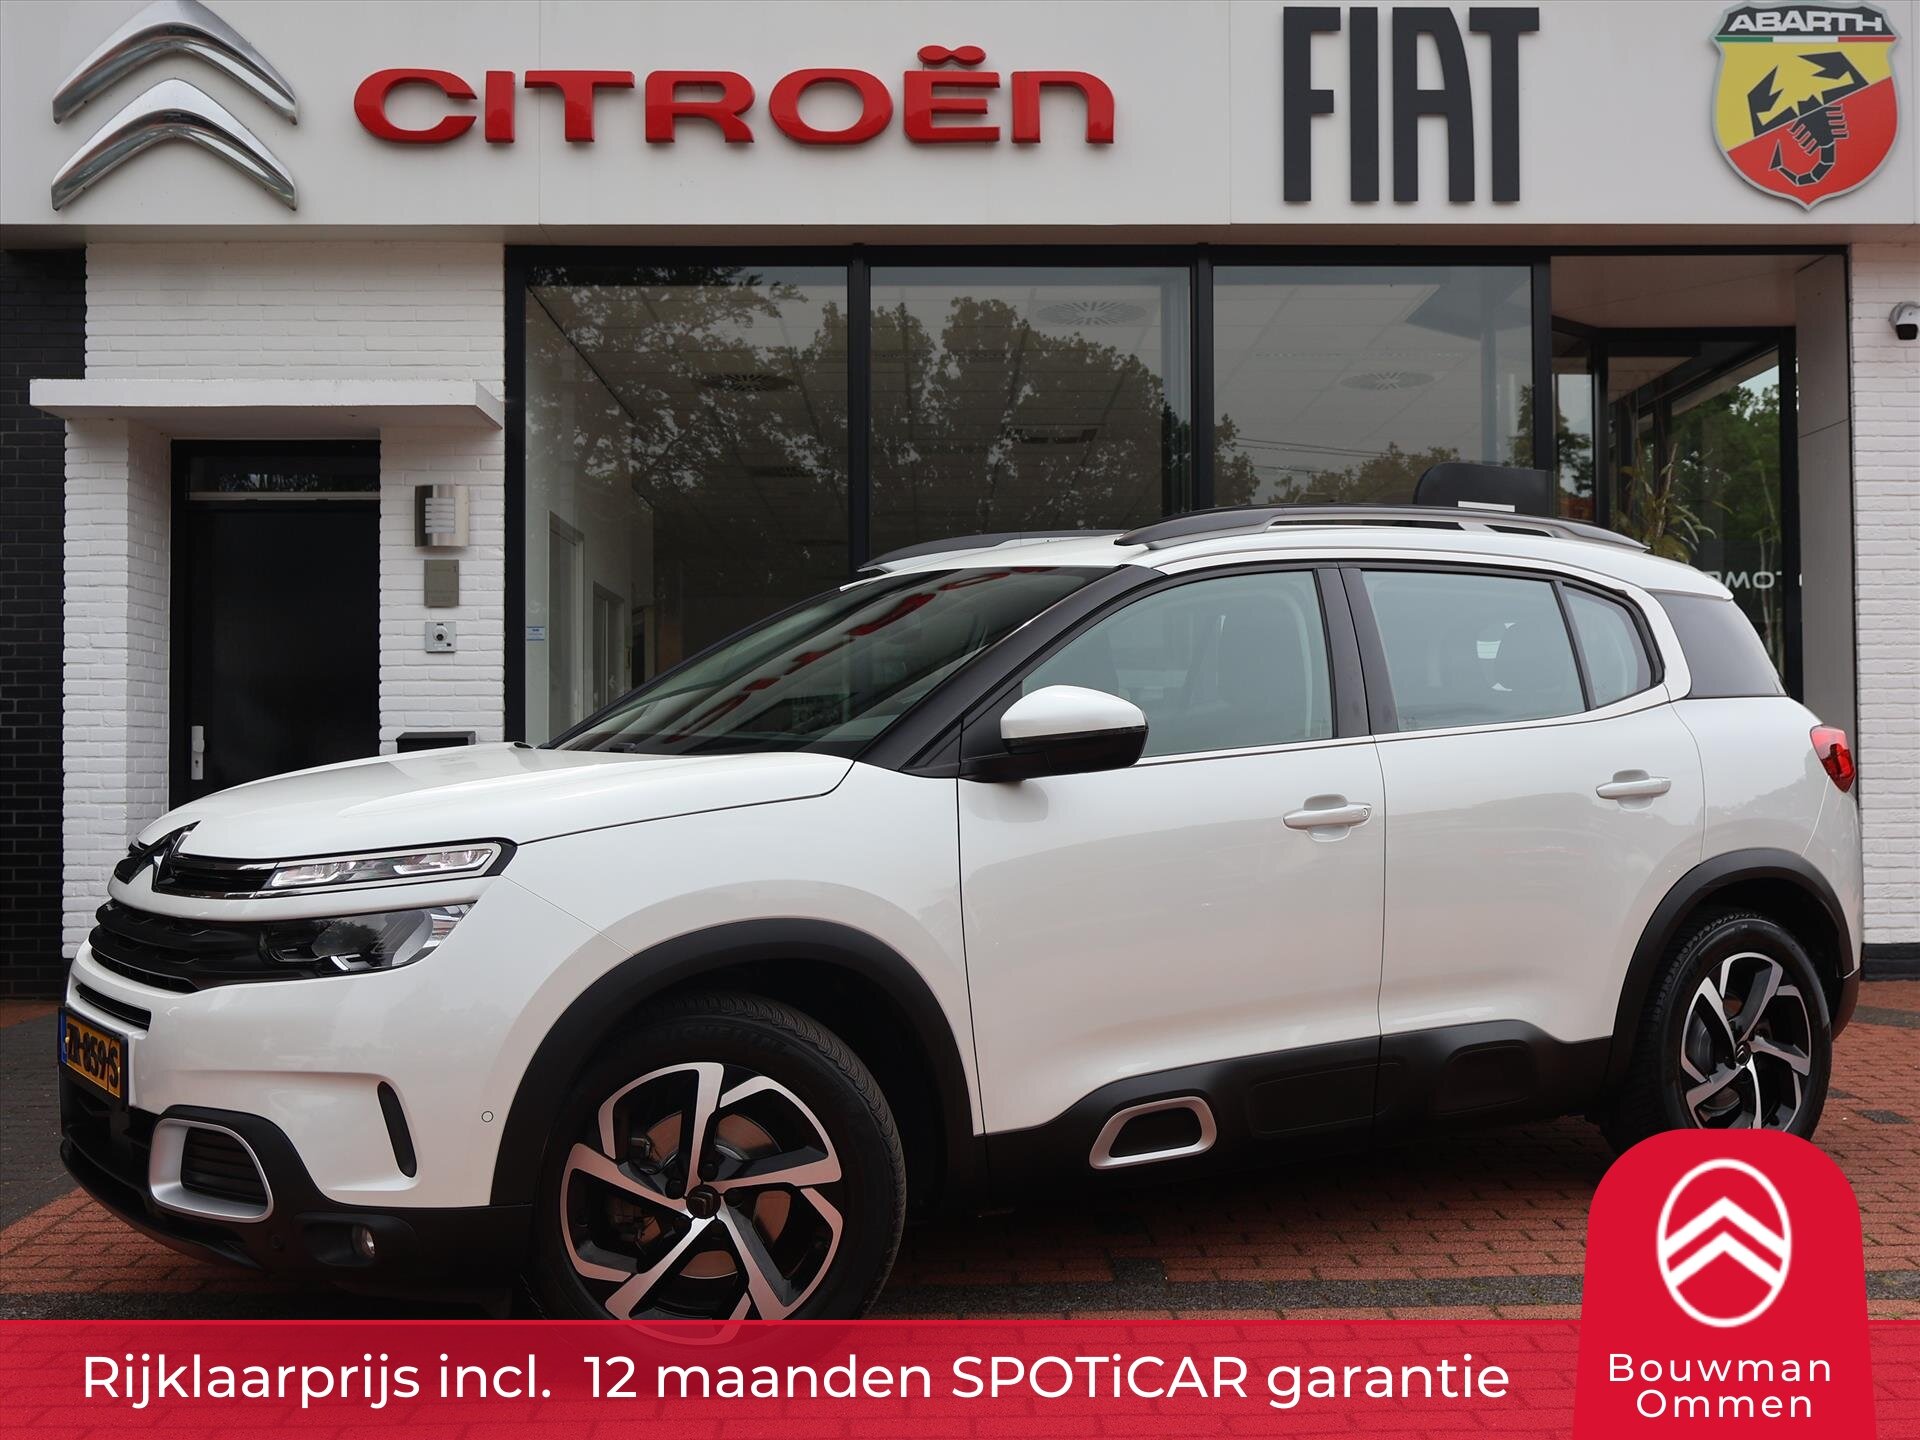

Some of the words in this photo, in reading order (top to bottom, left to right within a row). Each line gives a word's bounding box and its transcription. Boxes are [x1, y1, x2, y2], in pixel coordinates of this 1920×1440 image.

[1728, 10, 1883, 32] ABARTH
[354, 44, 1115, 144] CITROËN
[1283, 6, 1540, 202] FIAT
